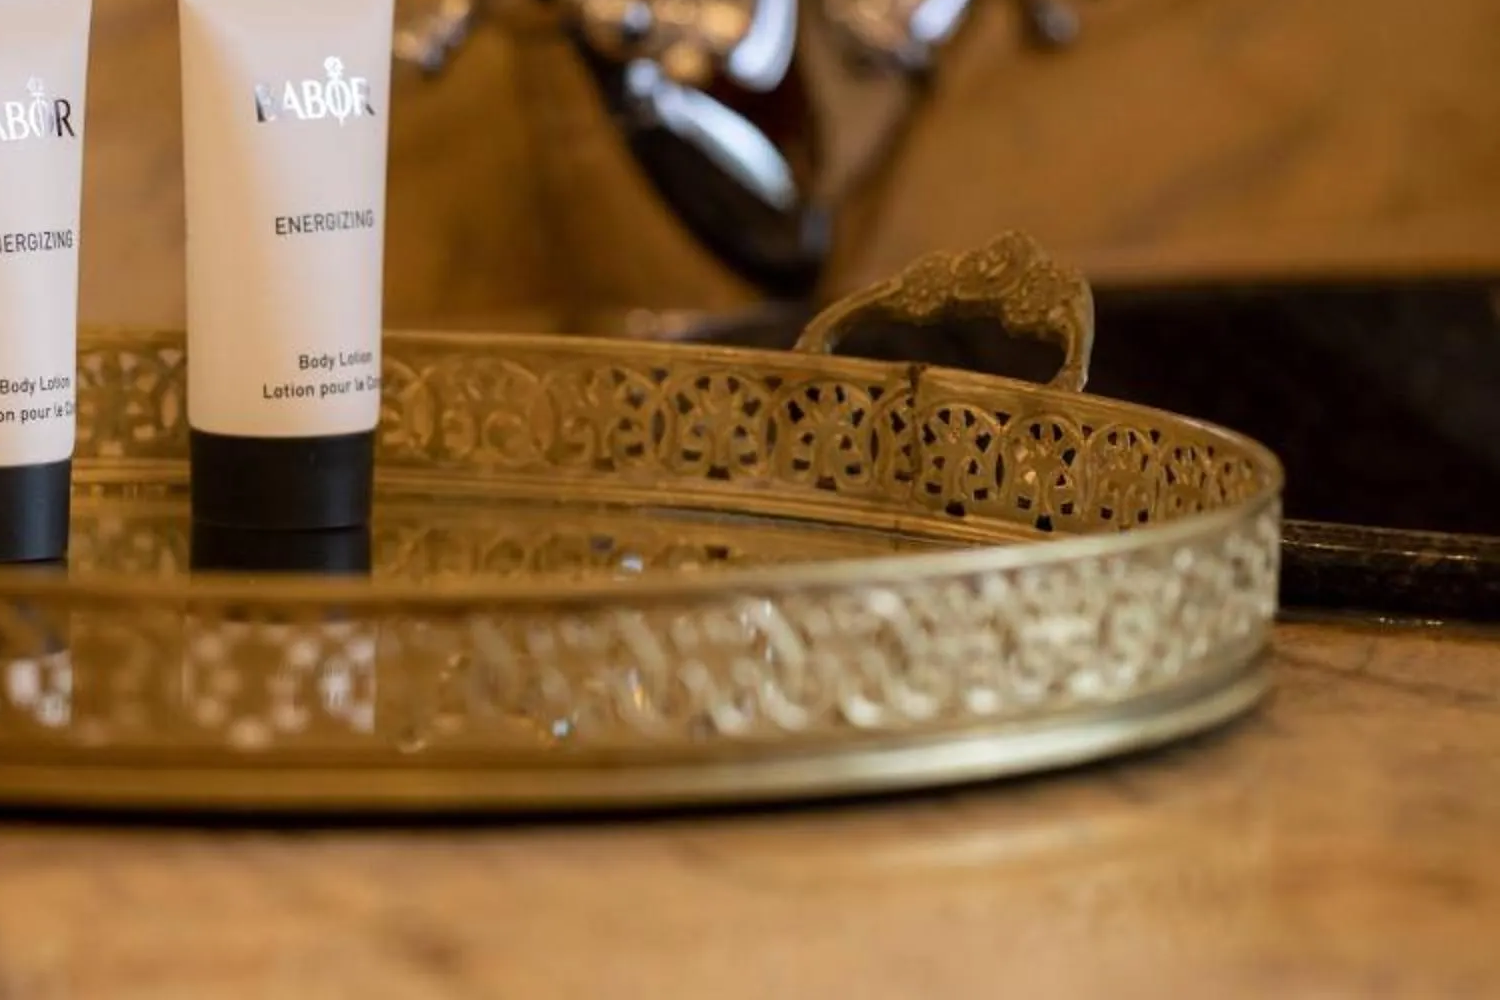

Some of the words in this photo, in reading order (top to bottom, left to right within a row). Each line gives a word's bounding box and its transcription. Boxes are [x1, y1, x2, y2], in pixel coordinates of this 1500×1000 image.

[275, 208, 373, 235] ENERGIZING
[299, 354, 336, 371] Body
[0, 378, 36, 397] Body
[263, 382, 315, 399] Lotion
[320, 380, 351, 399] pour
[20, 406, 51, 424] pour
